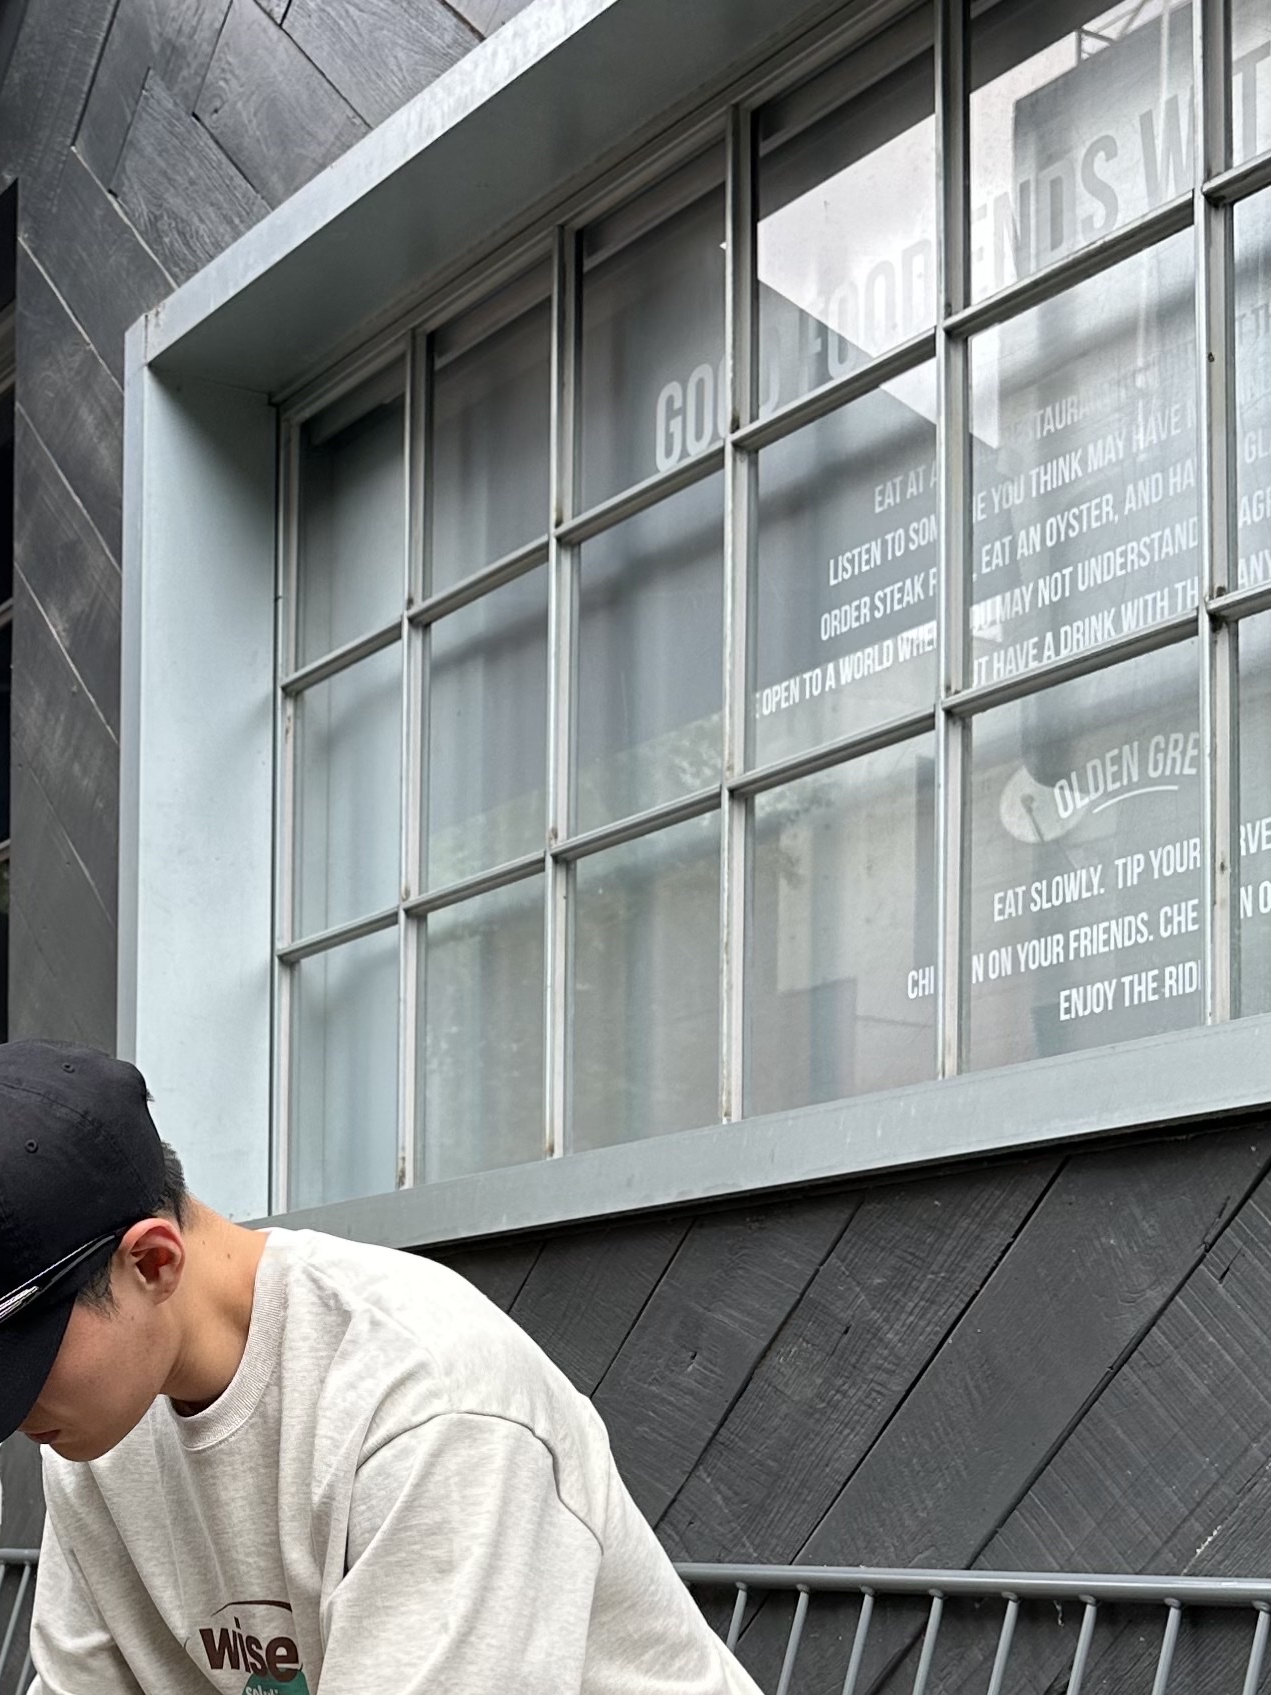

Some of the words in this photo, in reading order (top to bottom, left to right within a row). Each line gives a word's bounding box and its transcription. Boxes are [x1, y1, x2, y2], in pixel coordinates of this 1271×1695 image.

[829, 538, 881, 587] LISTEN
[885, 528, 905, 561] TO
[991, 474, 1026, 515] YOU
[1030, 449, 1083, 499] THINK
[1087, 429, 1126, 474] MAY
[1132, 399, 1182, 455] HAVE
[874, 474, 904, 514] EAT
[907, 463, 927, 500] AT
[821, 596, 871, 641] ORDER
[874, 571, 925, 619] STEAK
[981, 535, 1013, 574] EAT
[1017, 523, 1041, 561] AN
[1045, 492, 1119, 549] OYSTER,
[1125, 471, 1164, 516] AND
[762, 677, 801, 717] OPEN
[803, 668, 823, 700] TO
[825, 661, 837, 693] A
[839, 639, 895, 687] WORLD
[999, 582, 1034, 624] MAY
[1038, 566, 1074, 609] NOT
[1077, 515, 1199, 592] UNDERSTAND
[993, 637, 1040, 682] HAVE
[1043, 631, 1057, 667] A
[1060, 607, 1117, 657] DRINK
[1121, 587, 1170, 634] WITH
[1053, 740, 1140, 820] OLDEN
[993, 885, 1026, 923] EAT
[1030, 863, 1106, 914] SLOWLY.
[1114, 853, 1145, 890] TIP
[1149, 837, 1201, 881] YOUR
[988, 941, 1012, 981] ON
[1016, 932, 1065, 974] YOUR
[1069, 910, 1155, 962] FRIENDS.
[1059, 978, 1118, 1022] ENJOY
[1121, 969, 1160, 1007] THE
[1164, 959, 1202, 998] RID
